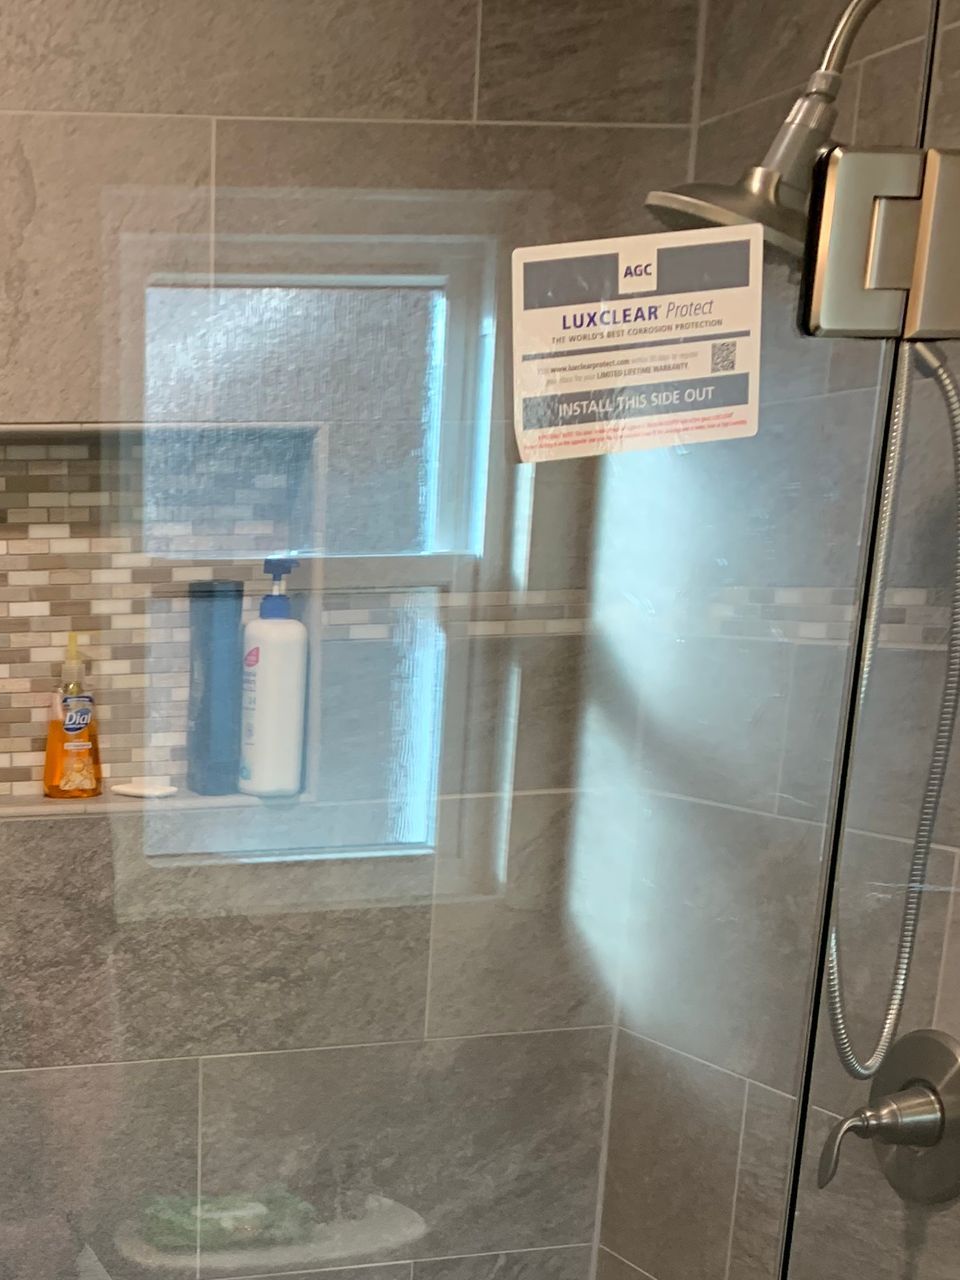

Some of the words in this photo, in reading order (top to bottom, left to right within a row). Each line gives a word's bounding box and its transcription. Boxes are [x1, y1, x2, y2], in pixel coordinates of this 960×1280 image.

[623, 263, 652, 279] AGC
[562, 305, 659, 330] LUXCLEAR
[666, 300, 714, 319] Protect
[551, 335, 566, 345] THE
[568, 331, 604, 344] WORLD'S
[606, 329, 625, 339] BEST
[627, 323, 673, 337] CORROSION
[675, 318, 723, 332] PROTECTION
[558, 399, 614, 417] INSTALL
[617, 393, 648, 410] THIS
[650, 390, 681, 407] SIDE
[684, 386, 715, 402] OUT
[65, 712, 91, 725] Dial
